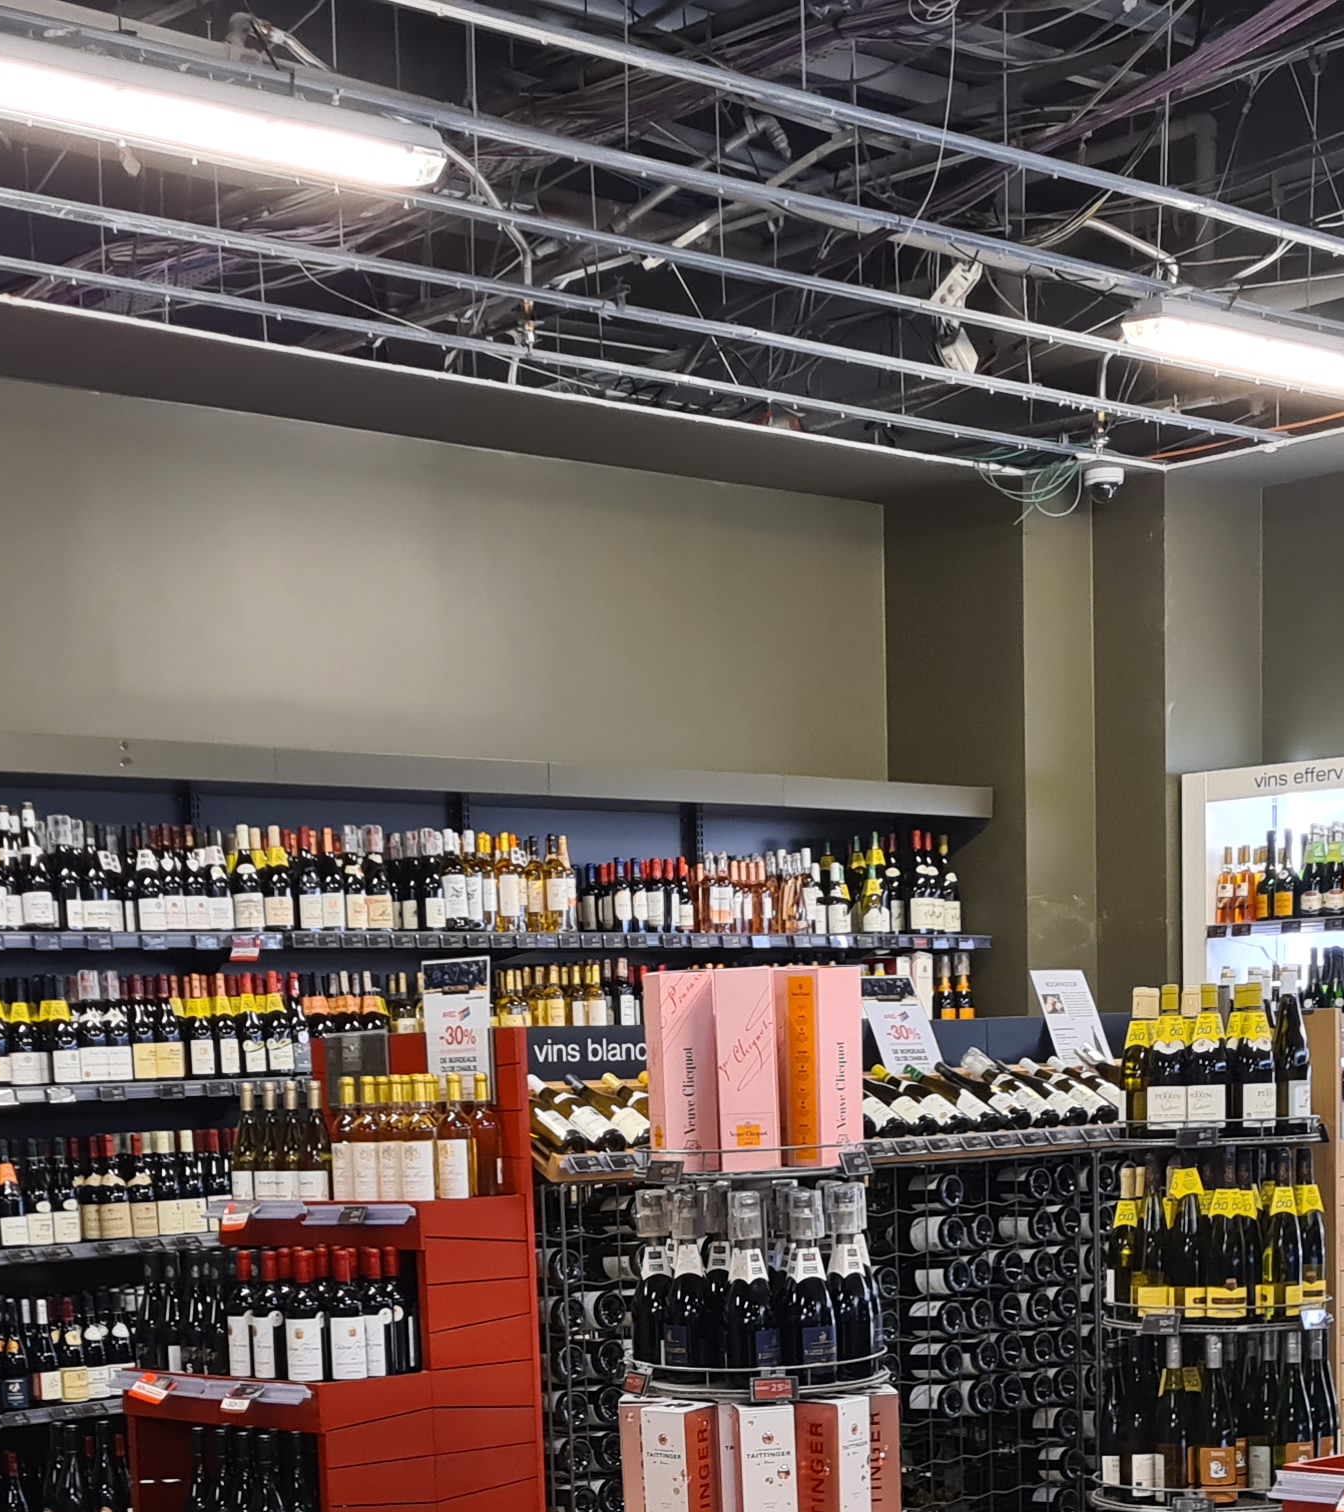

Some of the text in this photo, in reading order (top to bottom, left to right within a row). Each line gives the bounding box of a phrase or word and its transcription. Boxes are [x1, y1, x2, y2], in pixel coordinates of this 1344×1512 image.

[1254, 772, 1288, 788] vins
[439, 1024, 477, 1045] -30%
[886, 1024, 922, 1041] -30%
[533, 1038, 581, 1063] vins
[682, 1046, 697, 1135] Veuve Clicquot
[835, 1041, 848, 1130] Veuve Clicquot
[646, 1451, 682, 1460] TAITTINGER
[746, 1450, 792, 1459] TAITTINGER
